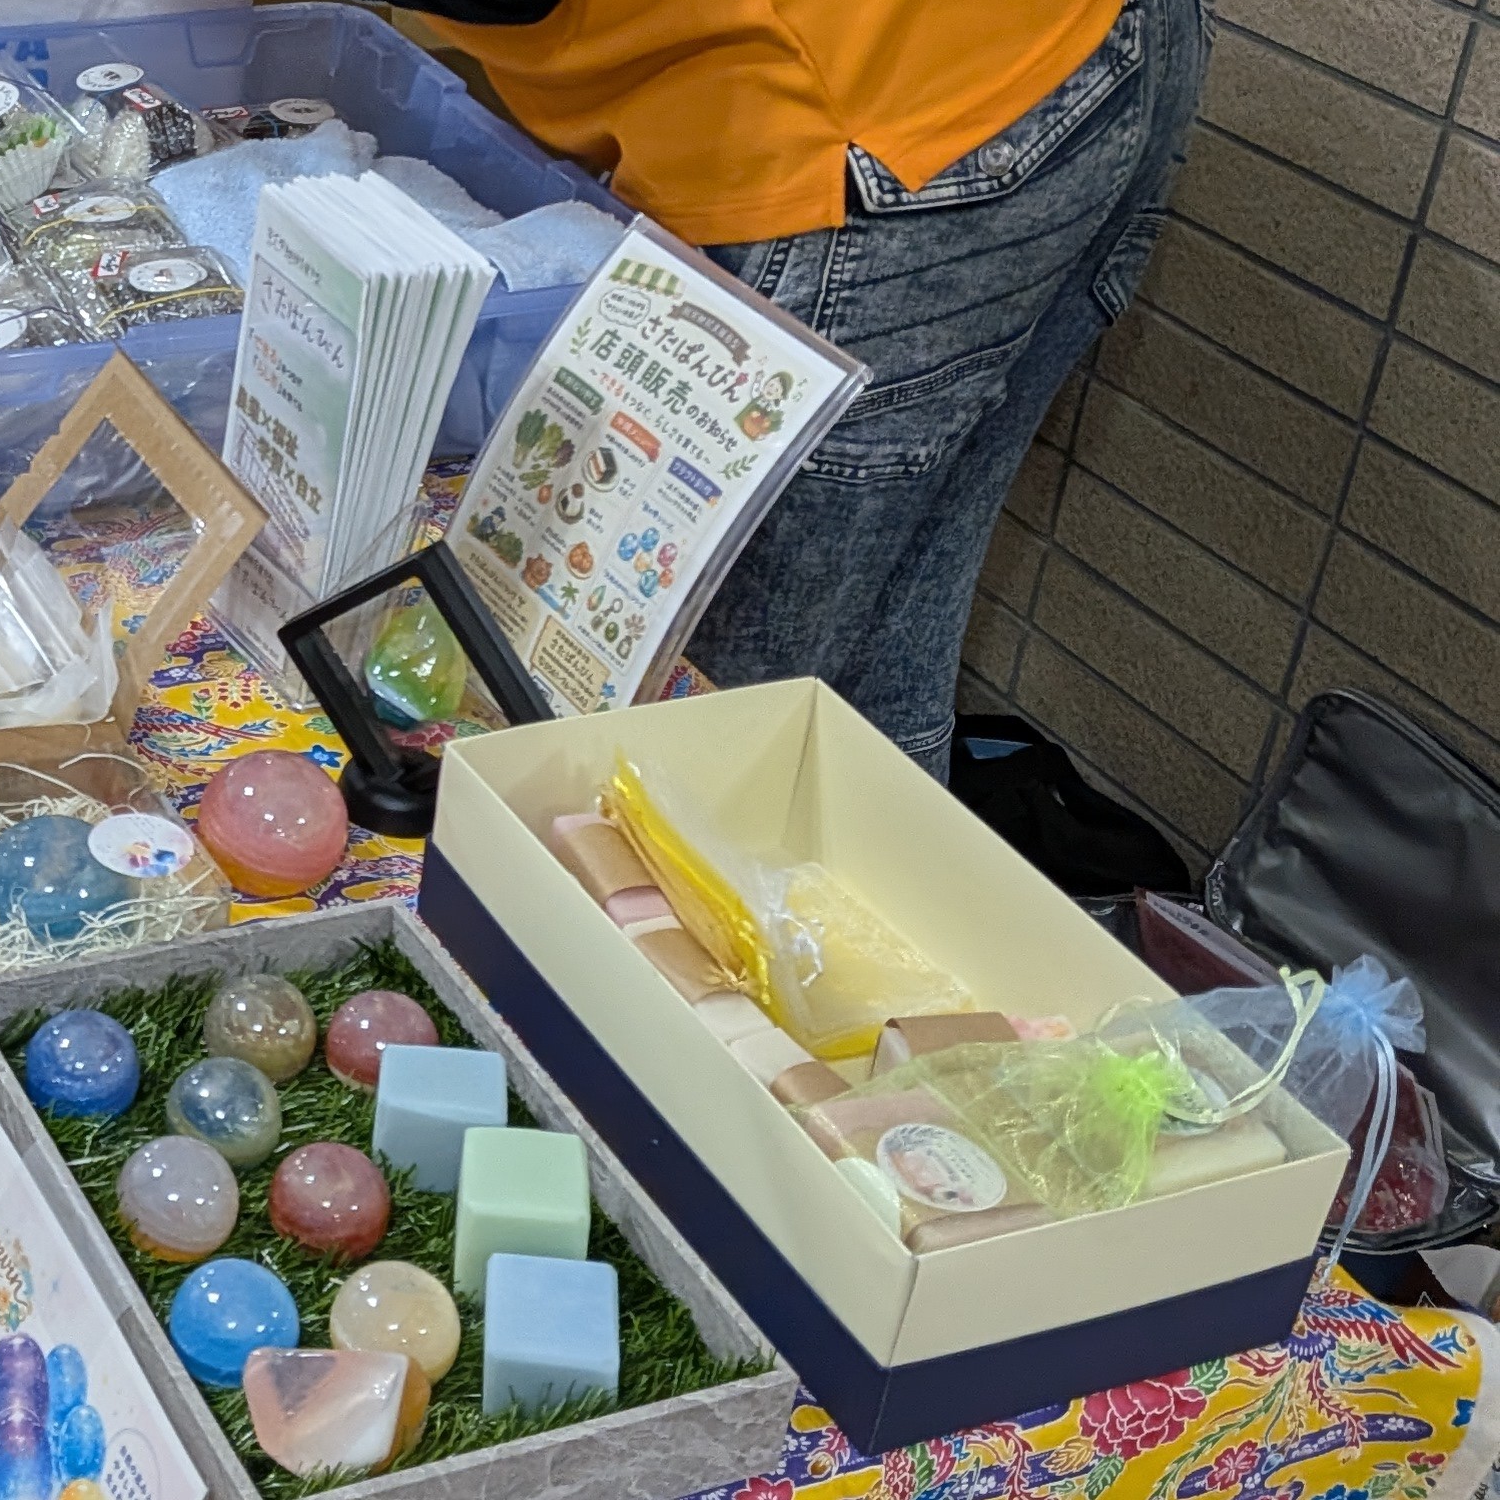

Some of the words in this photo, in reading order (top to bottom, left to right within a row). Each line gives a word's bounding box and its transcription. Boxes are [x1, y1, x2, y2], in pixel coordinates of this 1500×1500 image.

[640, 315, 742, 404] さたぱんびん
